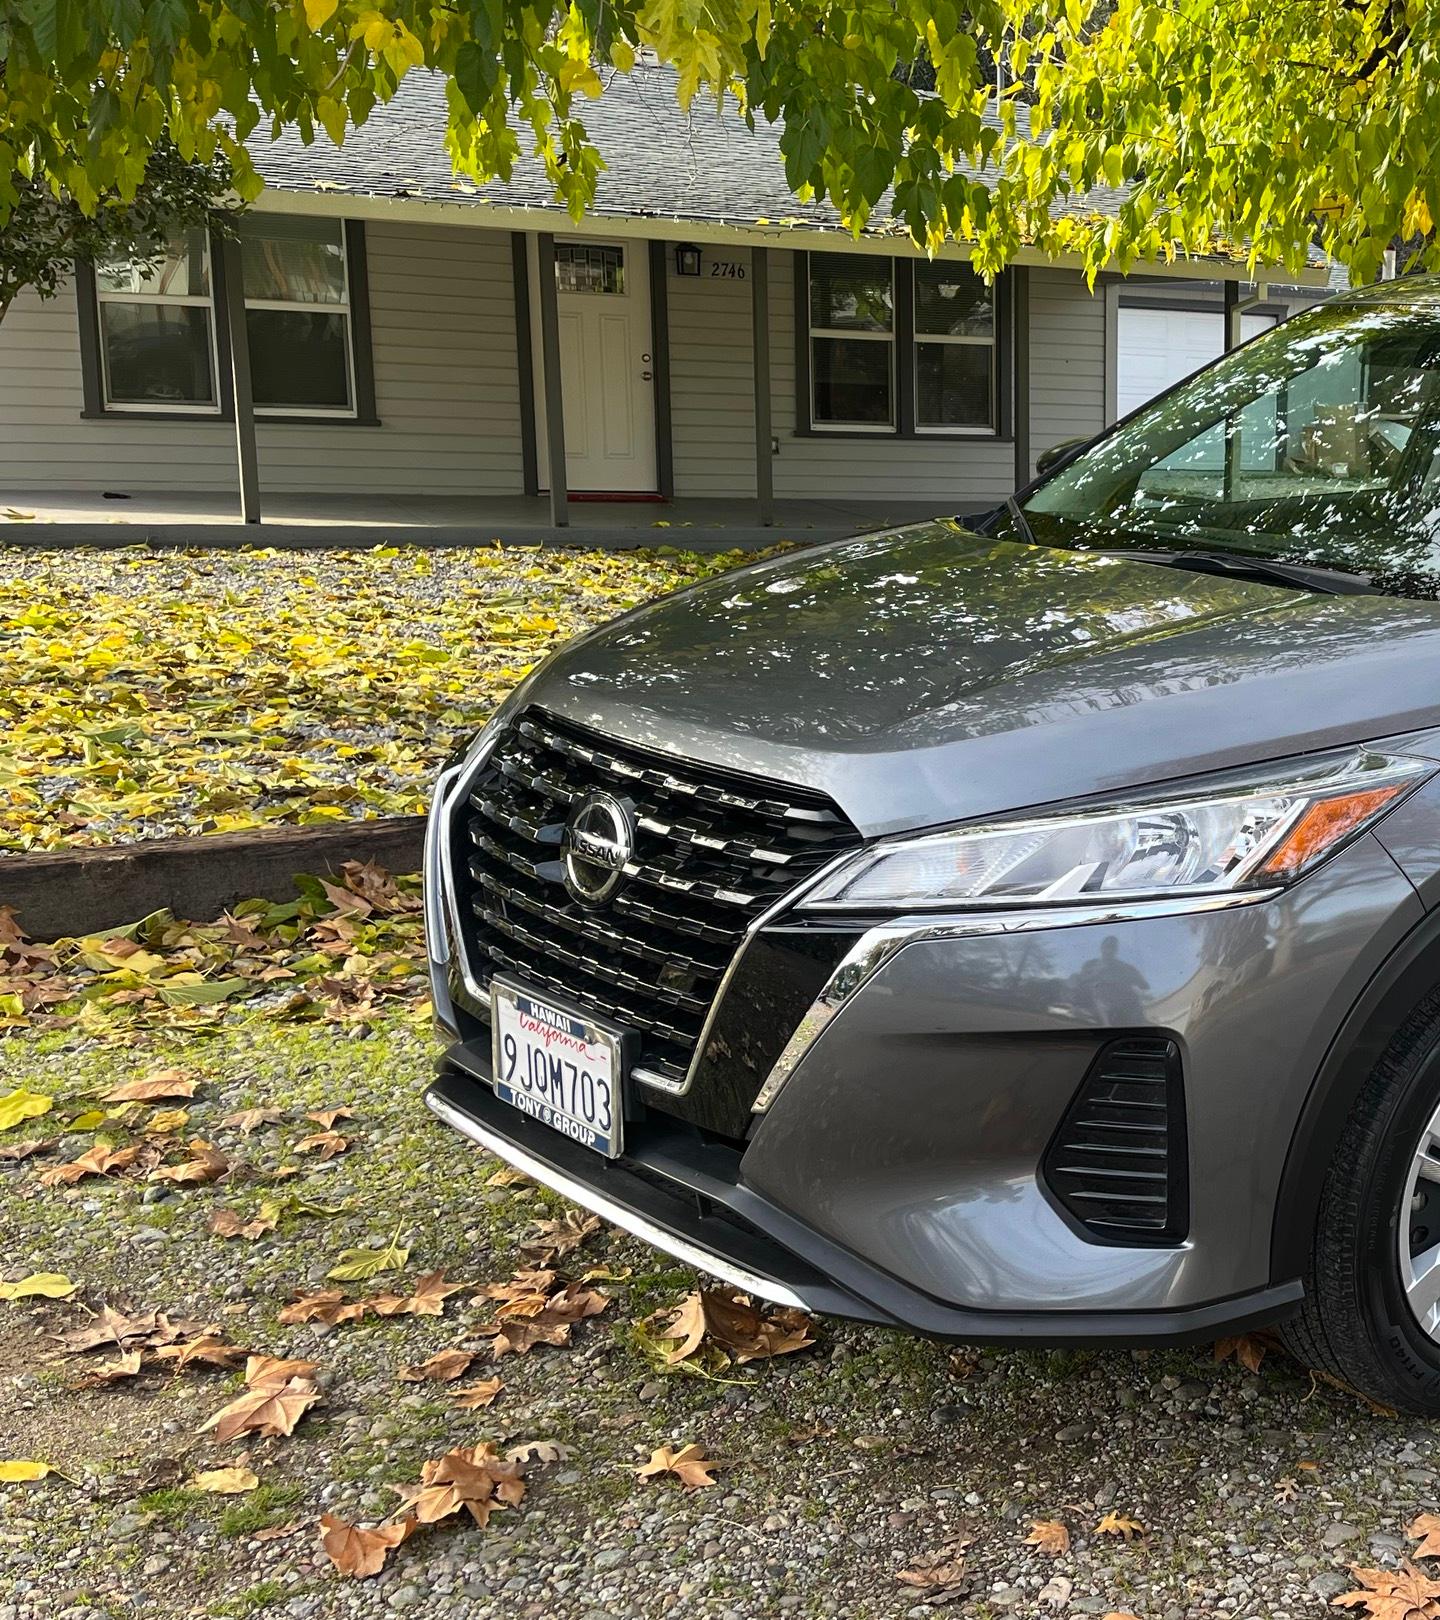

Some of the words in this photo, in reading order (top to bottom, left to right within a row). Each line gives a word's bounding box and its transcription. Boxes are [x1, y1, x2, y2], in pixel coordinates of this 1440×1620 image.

[712, 262, 745, 279] 2746
[530, 1002, 571, 1033] HAWAII
[504, 1033, 612, 1132] 9JQM703
[510, 1088, 541, 1118] TONY
[553, 1112, 596, 1146] GROUP
